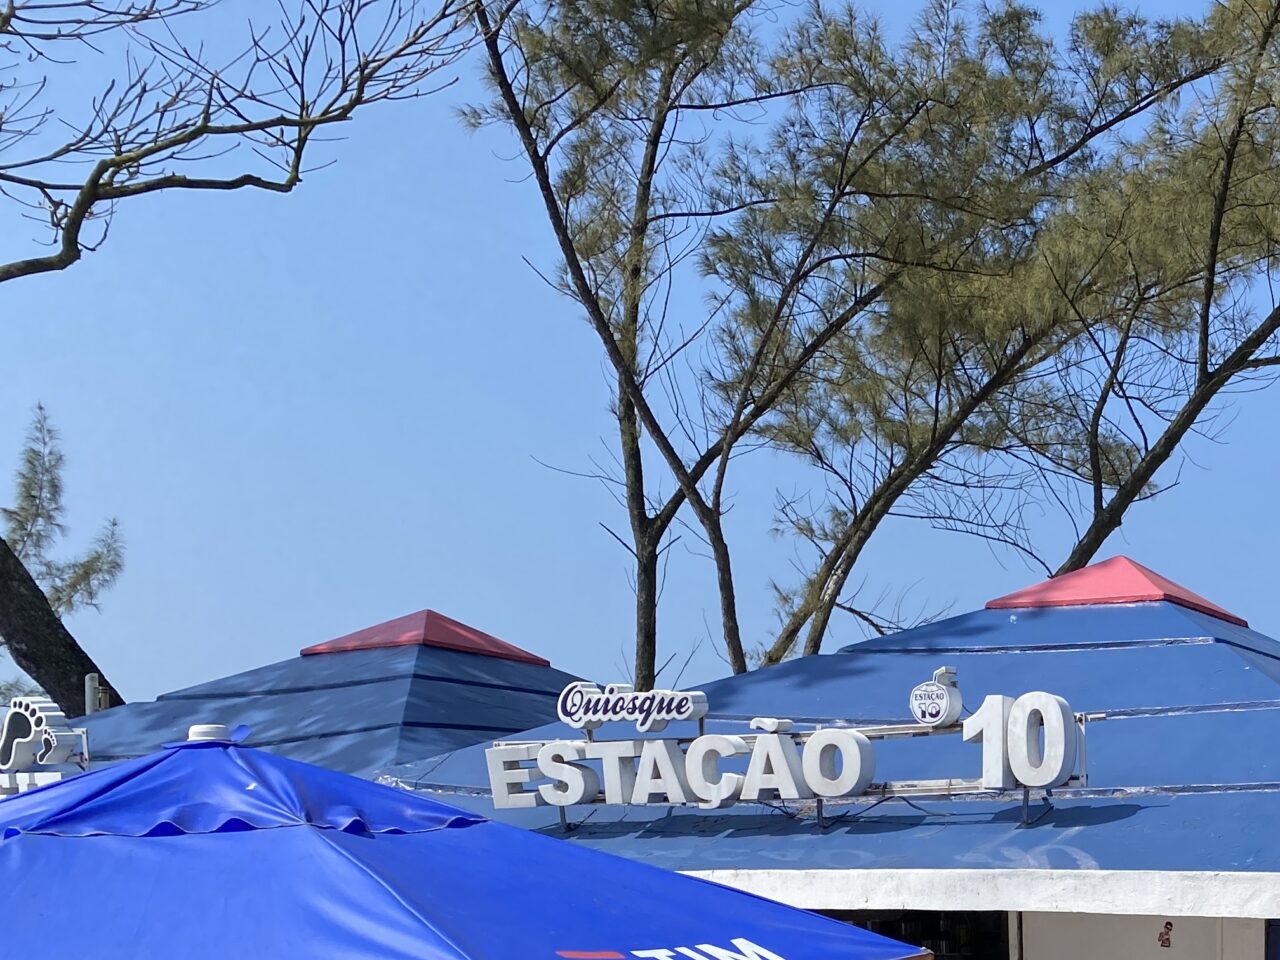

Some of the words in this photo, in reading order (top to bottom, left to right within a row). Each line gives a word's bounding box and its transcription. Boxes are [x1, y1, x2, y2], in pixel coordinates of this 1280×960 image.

[559, 683, 692, 728] Quiosque
[918, 701, 941, 719] 10
[485, 717, 870, 809] ESTAÇÃO
[962, 690, 1070, 790] 10
